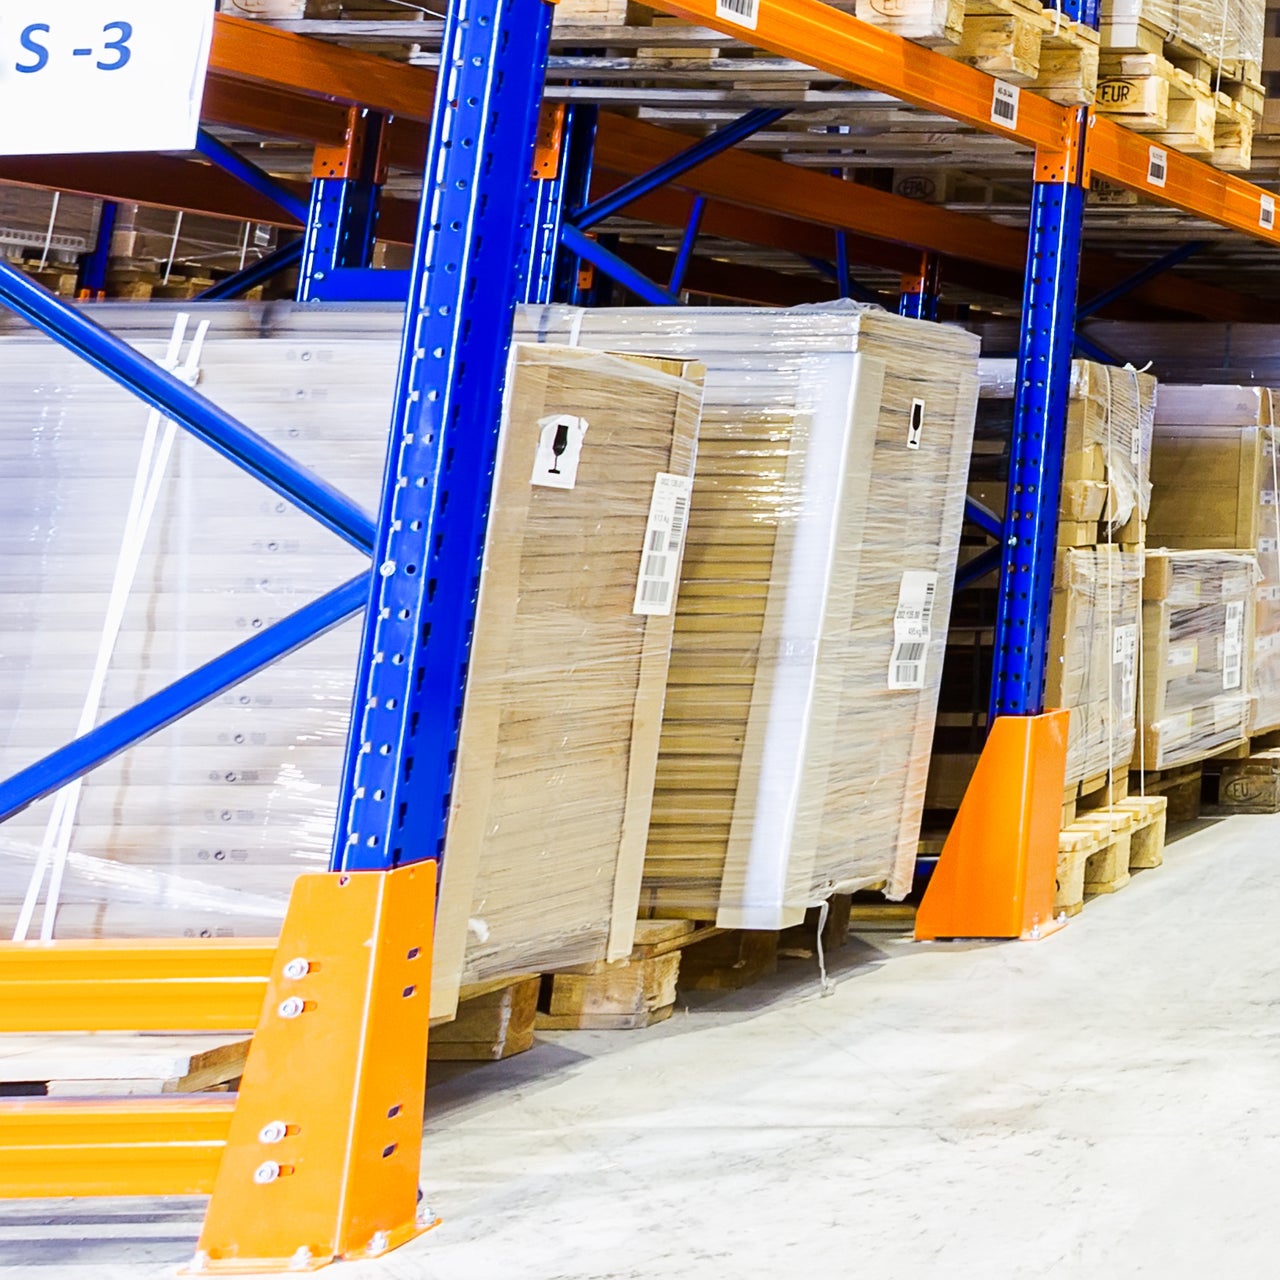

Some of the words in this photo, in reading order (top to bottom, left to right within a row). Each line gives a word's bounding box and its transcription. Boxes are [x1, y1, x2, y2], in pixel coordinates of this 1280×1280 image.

[16, 23, 50, 73] S
[73, 21, 133, 71] -3
[1102, 85, 1130, 102] EUR
